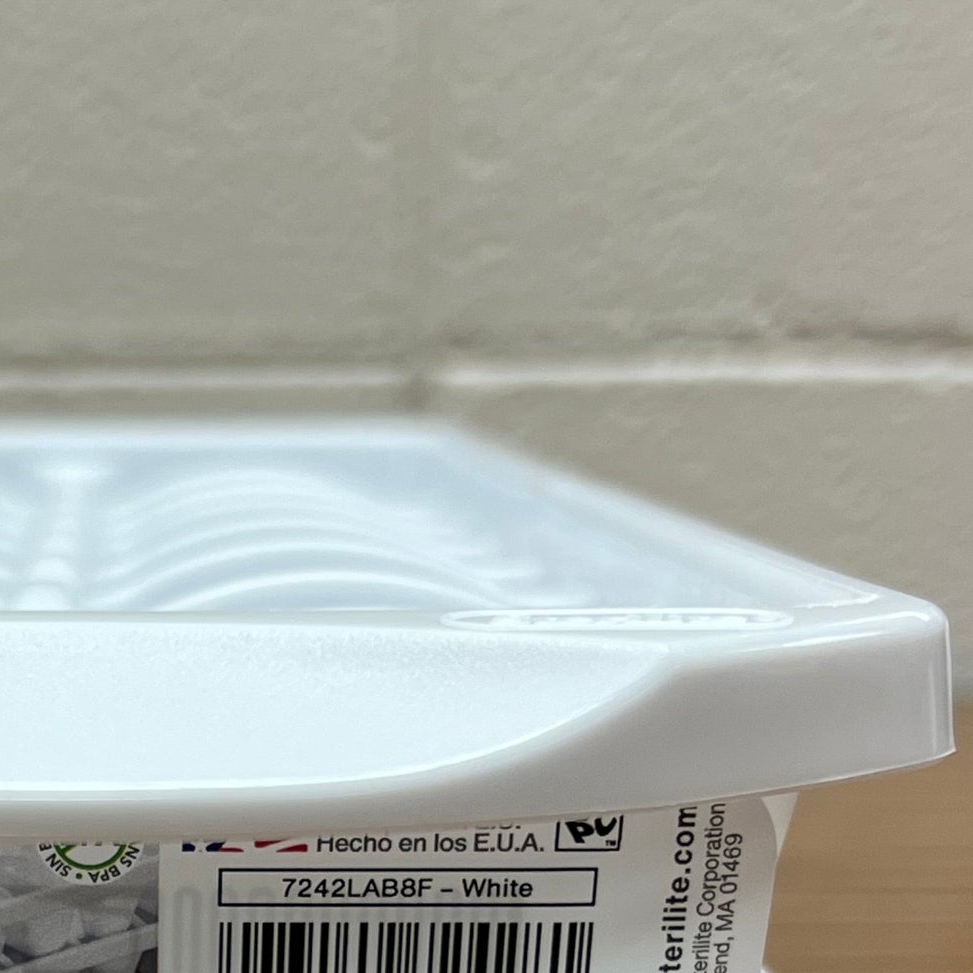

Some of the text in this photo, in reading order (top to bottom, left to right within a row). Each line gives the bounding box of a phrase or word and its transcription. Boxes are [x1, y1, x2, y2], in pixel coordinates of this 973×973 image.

[317, 834, 392, 852] Hecho
[399, 838, 426, 852] en
[433, 833, 467, 852] los
[474, 833, 544, 852] E.U.A.
[696, 803, 726, 917] Corporation
[719, 833, 743, 895] 01469
[282, 877, 433, 898] 7242LAB8F
[462, 878, 534, 898] White
[715, 899, 736, 932] MA
